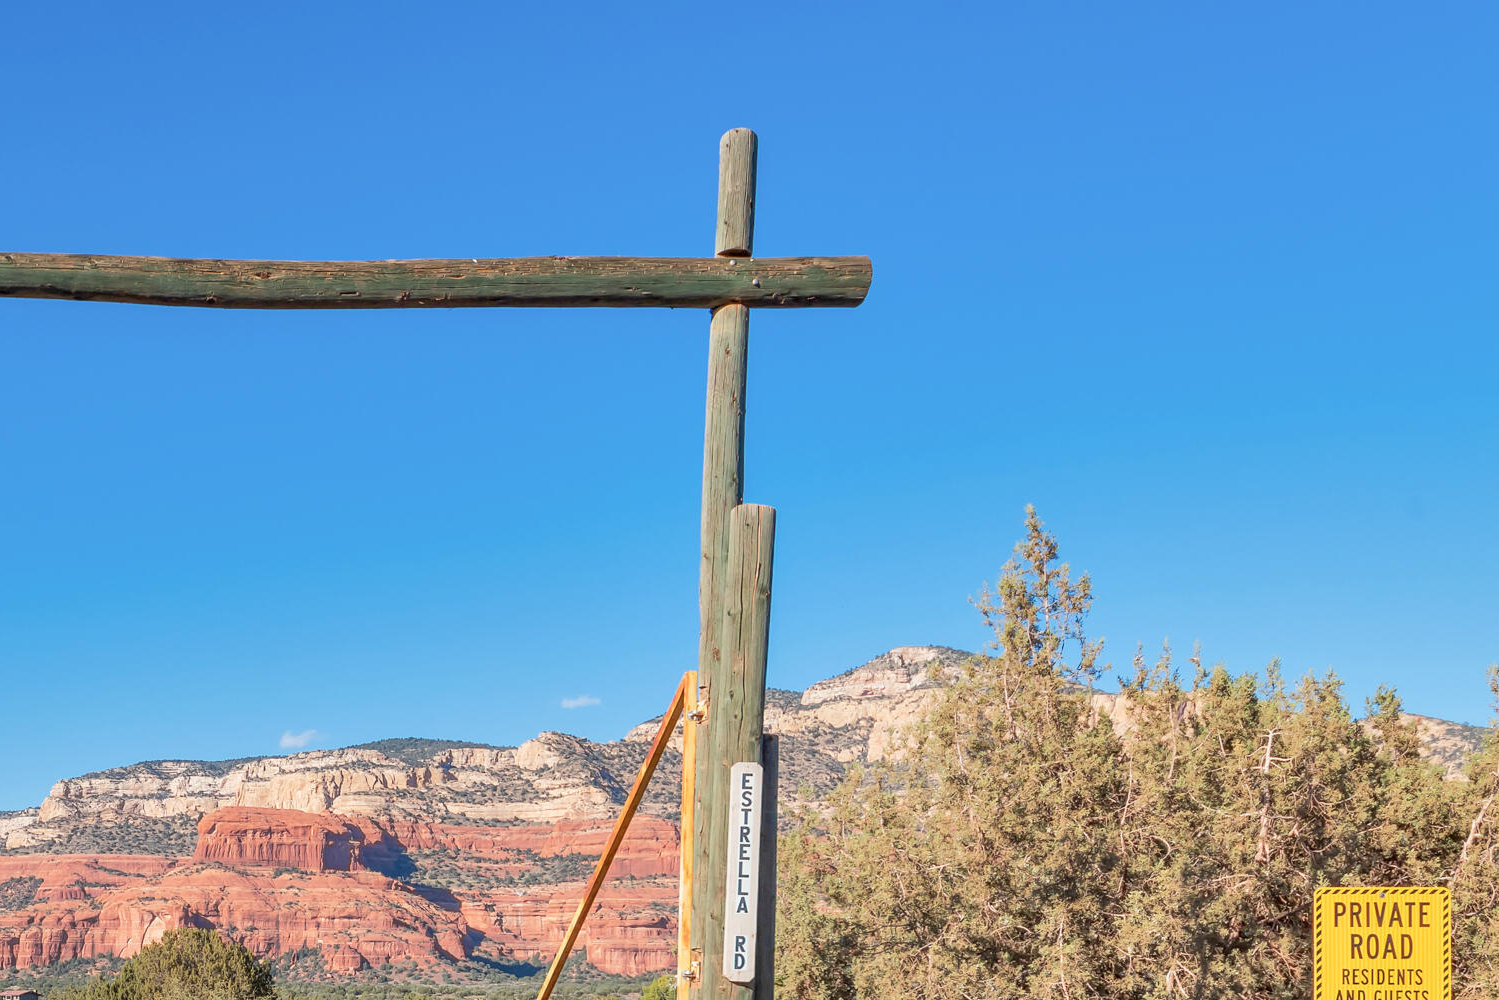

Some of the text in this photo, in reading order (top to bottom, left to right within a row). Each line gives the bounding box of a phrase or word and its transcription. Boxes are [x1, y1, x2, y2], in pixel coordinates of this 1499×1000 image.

[733, 773, 754, 970] ESTRELLA RD
[1333, 902, 1431, 928] PRIVATE
[1350, 933, 1414, 960] ROAD
[1342, 968, 1423, 985] RESIDENTS
